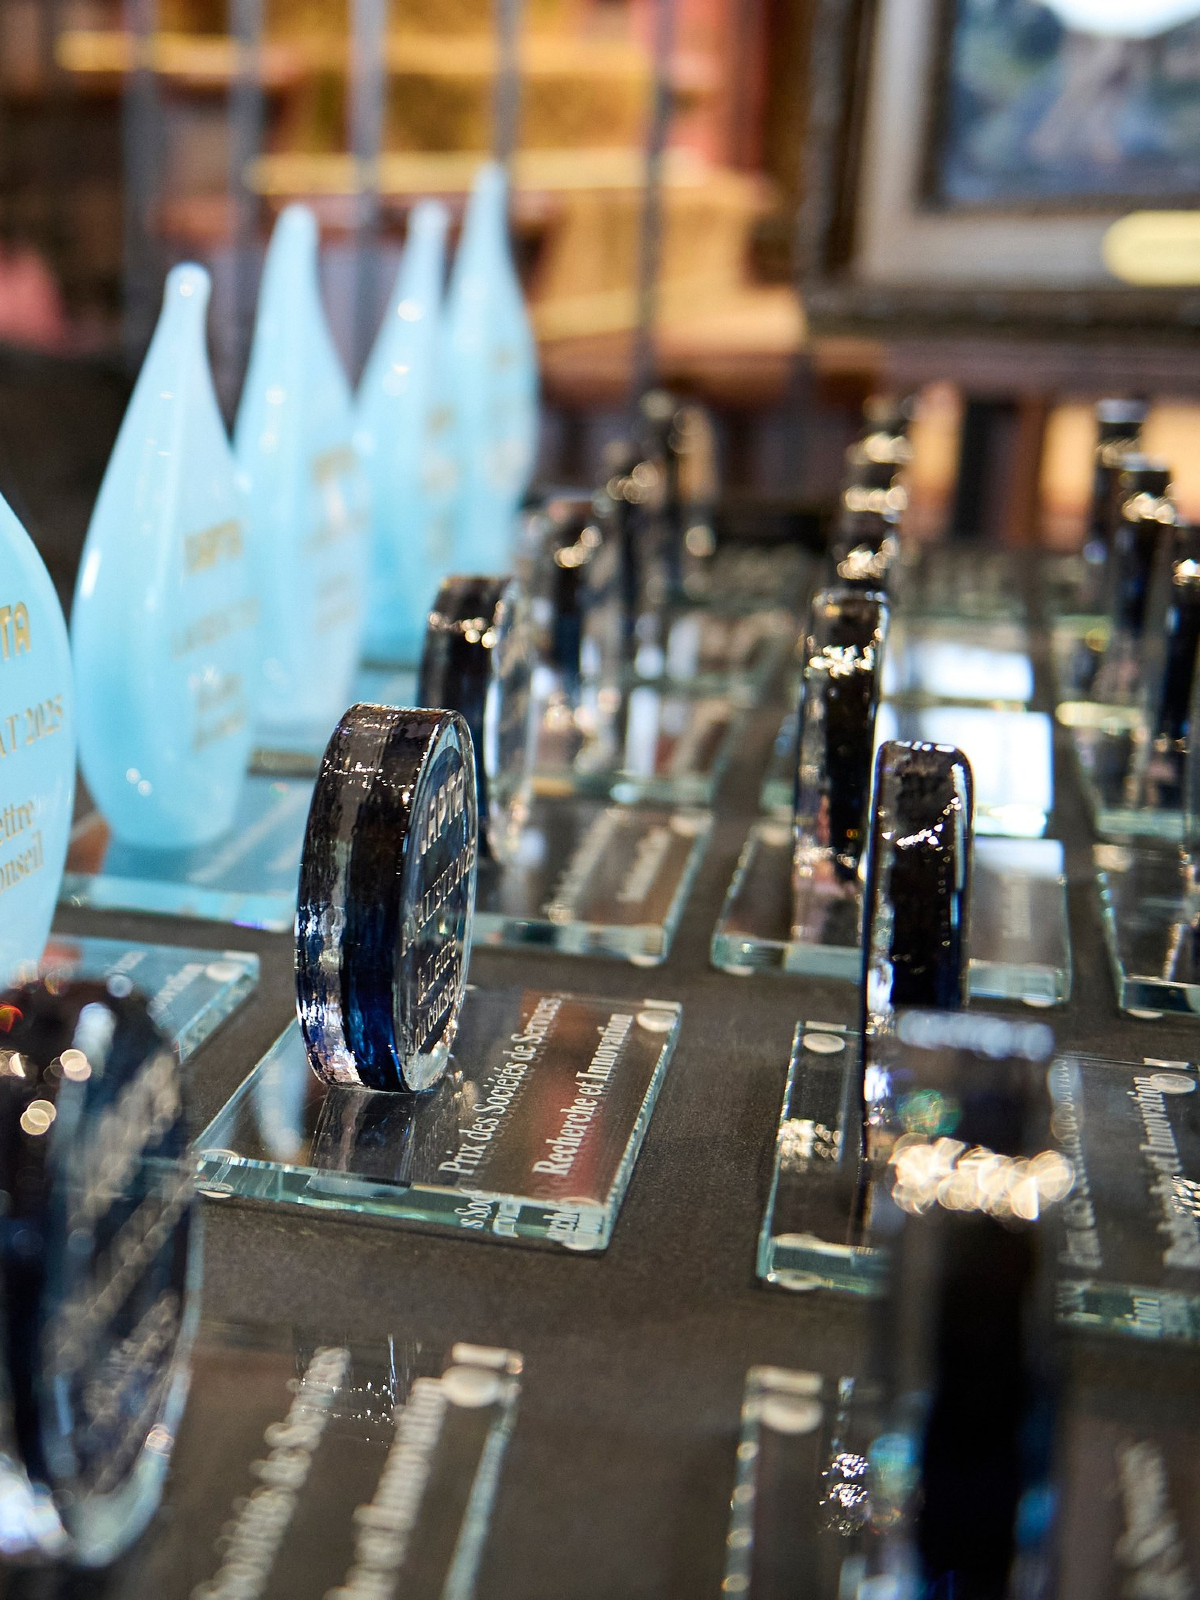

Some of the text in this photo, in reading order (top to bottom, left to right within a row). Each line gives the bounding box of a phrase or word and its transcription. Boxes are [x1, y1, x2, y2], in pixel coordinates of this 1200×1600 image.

[25, 694, 65, 746] 2025
[511, 997, 564, 1044] Services
[502, 1044, 537, 1062] de
[575, 1013, 634, 1082] Innovation
[472, 1062, 529, 1115] Sociétés
[574, 1080, 604, 1097] et
[458, 1116, 500, 1141] des
[532, 1098, 598, 1176] Recherche
[438, 1142, 487, 1176] Prix
